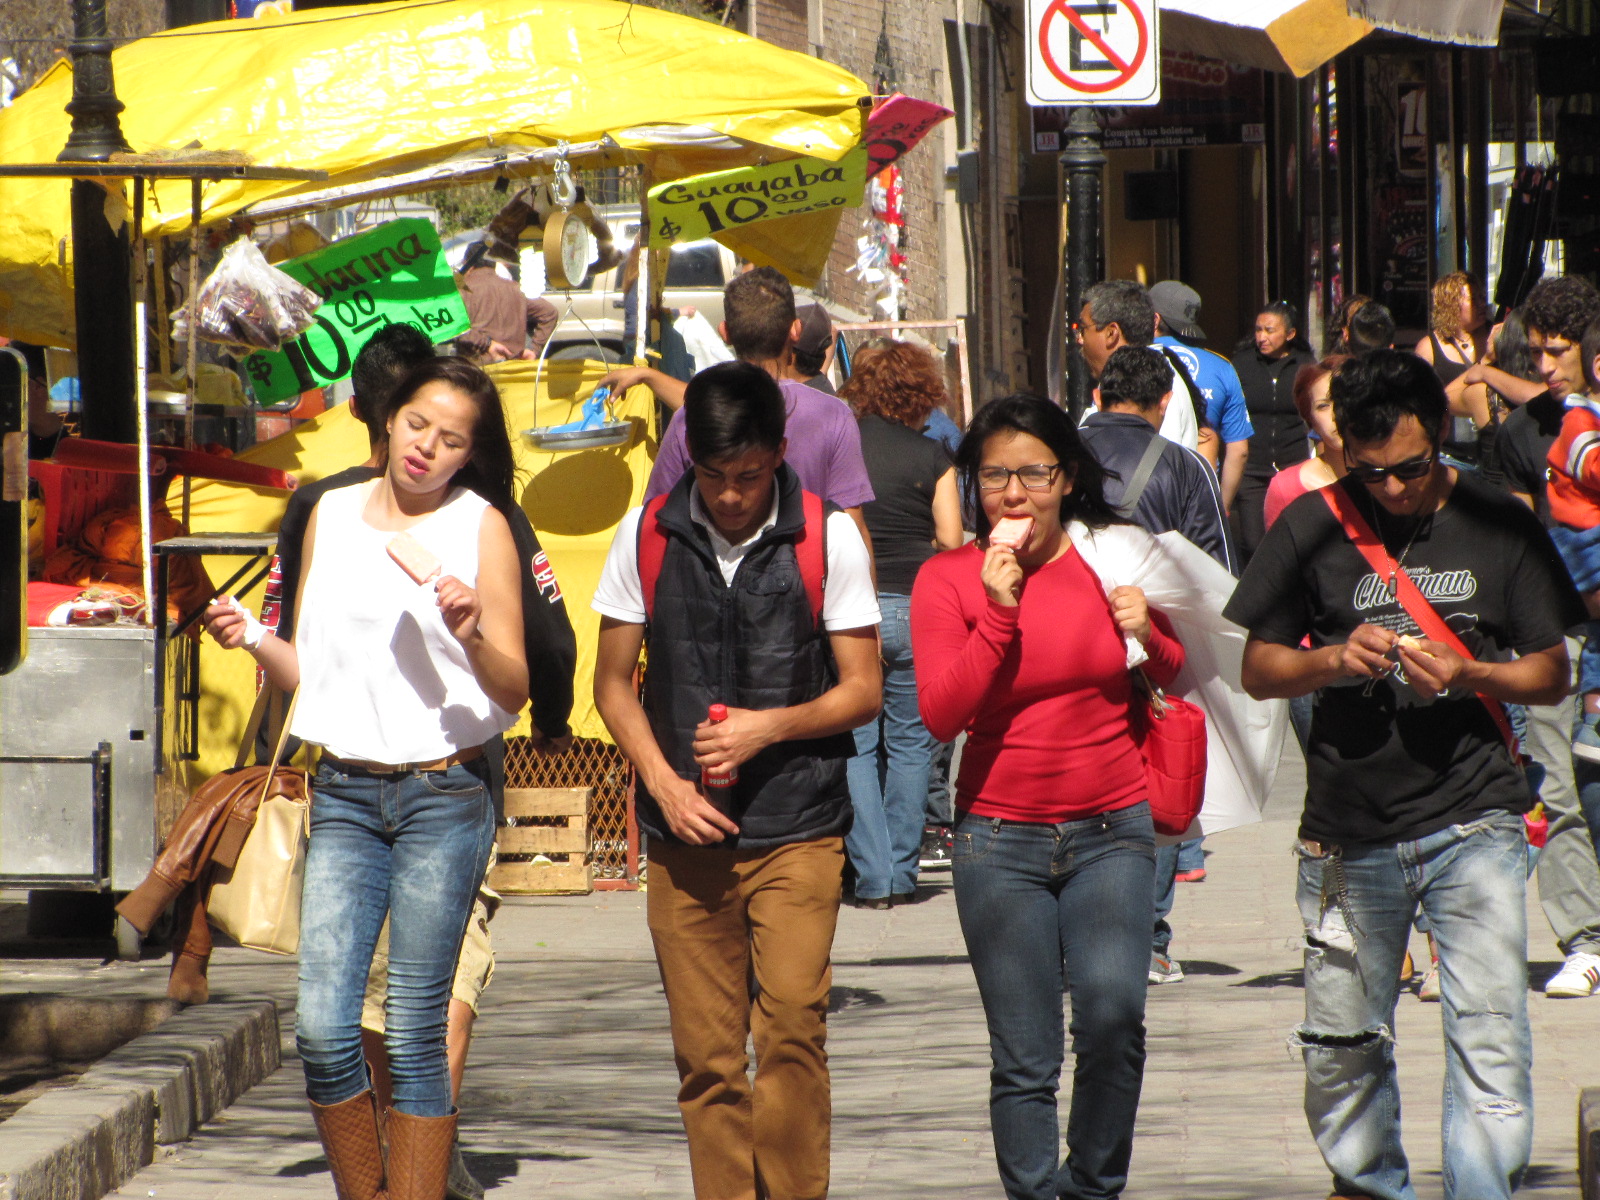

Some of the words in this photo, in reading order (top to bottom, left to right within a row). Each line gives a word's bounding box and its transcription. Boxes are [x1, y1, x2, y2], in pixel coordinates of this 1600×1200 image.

[1069, 4, 1126, 72] E
[1104, 128, 1140, 139] Compra
[1143, 127, 1158, 136] tus
[1160, 125, 1193, 135] boletos
[1151, 136, 1183, 147] pesitos
[657, 164, 846, 204] Guayaba
[775, 196, 847, 217] vaso
